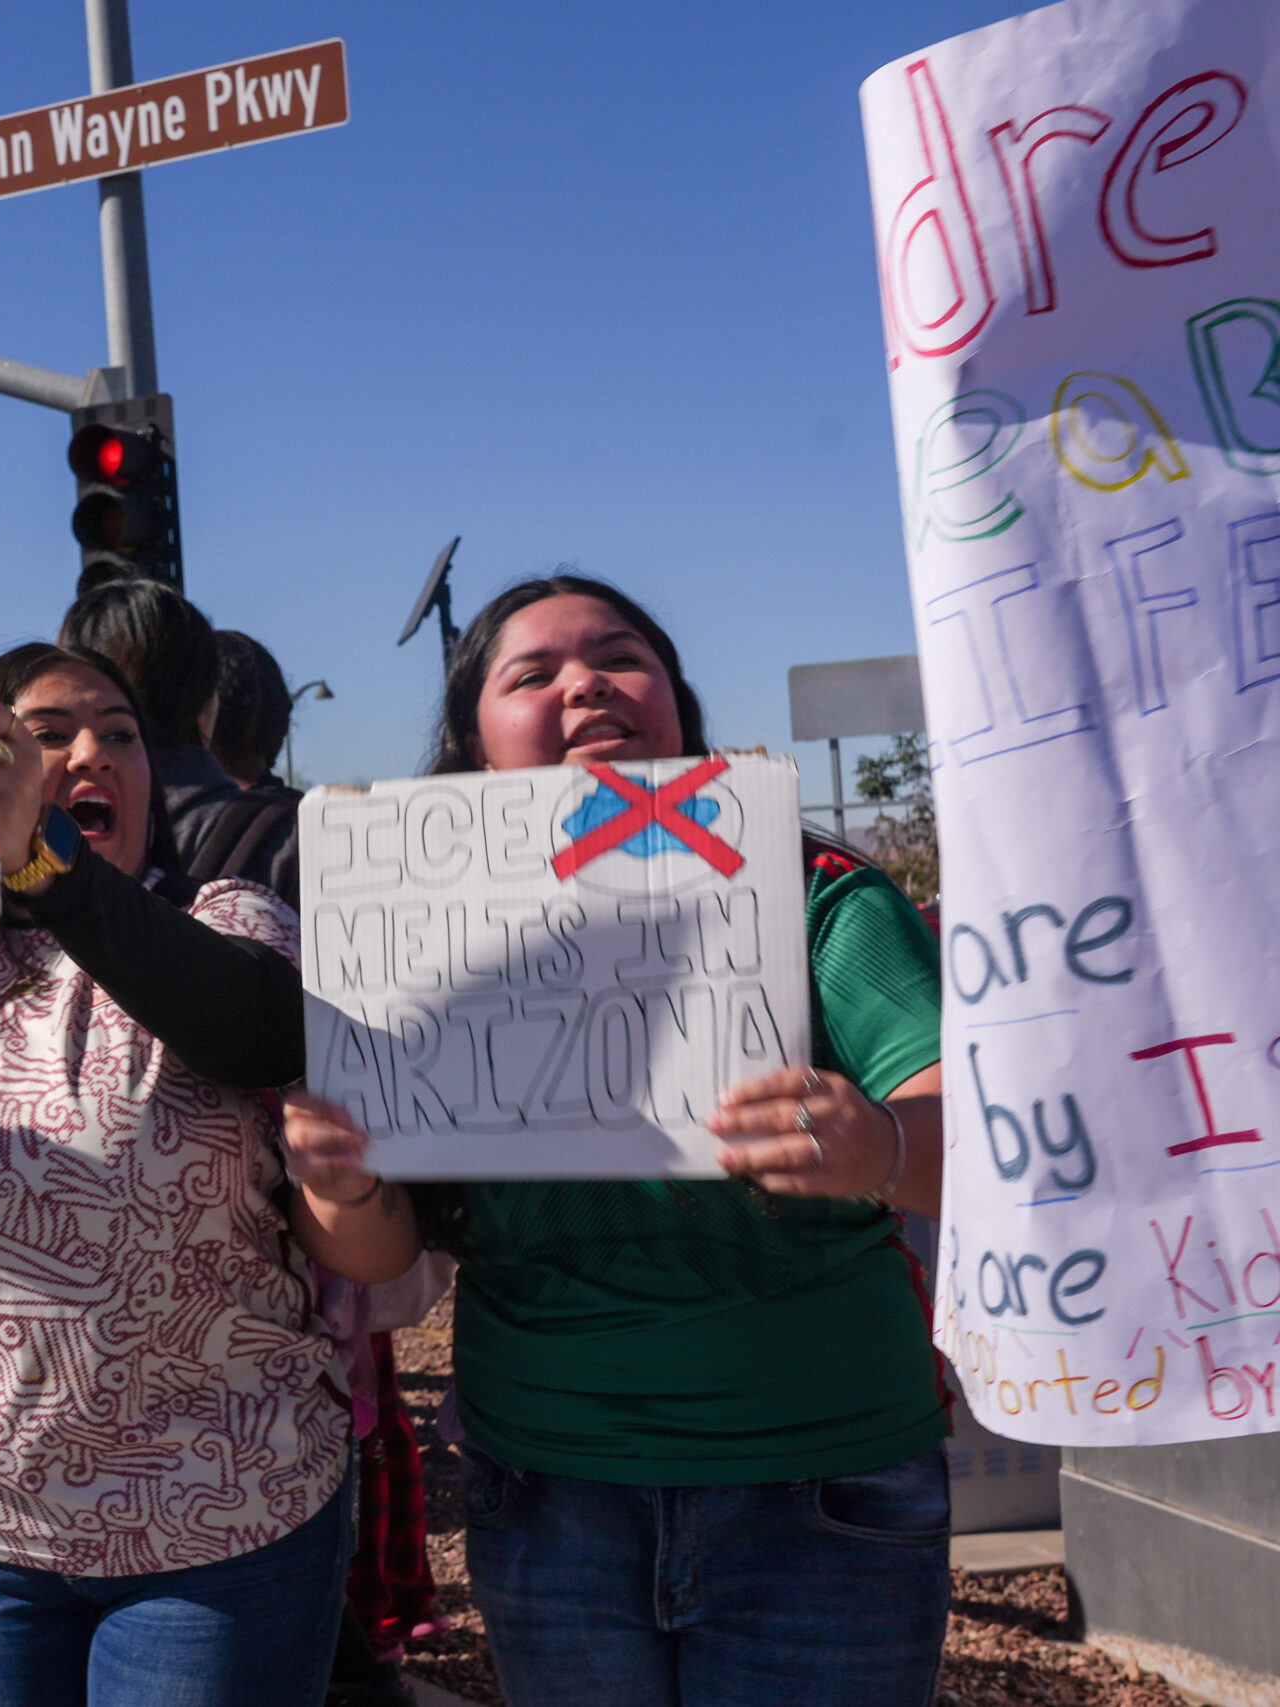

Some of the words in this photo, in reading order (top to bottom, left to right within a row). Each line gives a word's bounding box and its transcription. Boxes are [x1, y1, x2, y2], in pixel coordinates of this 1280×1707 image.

[49, 95, 186, 168] Wayne
[205, 64, 322, 132] Pkwy
[321, 778, 546, 895] ICE
[315, 893, 587, 996] MELTS
[616, 886, 762, 986] IN
[949, 895, 1135, 1005] are
[323, 981, 791, 1138] ARIZONA
[969, 1042, 1097, 1191] by
[978, 1249, 1107, 1326] are
